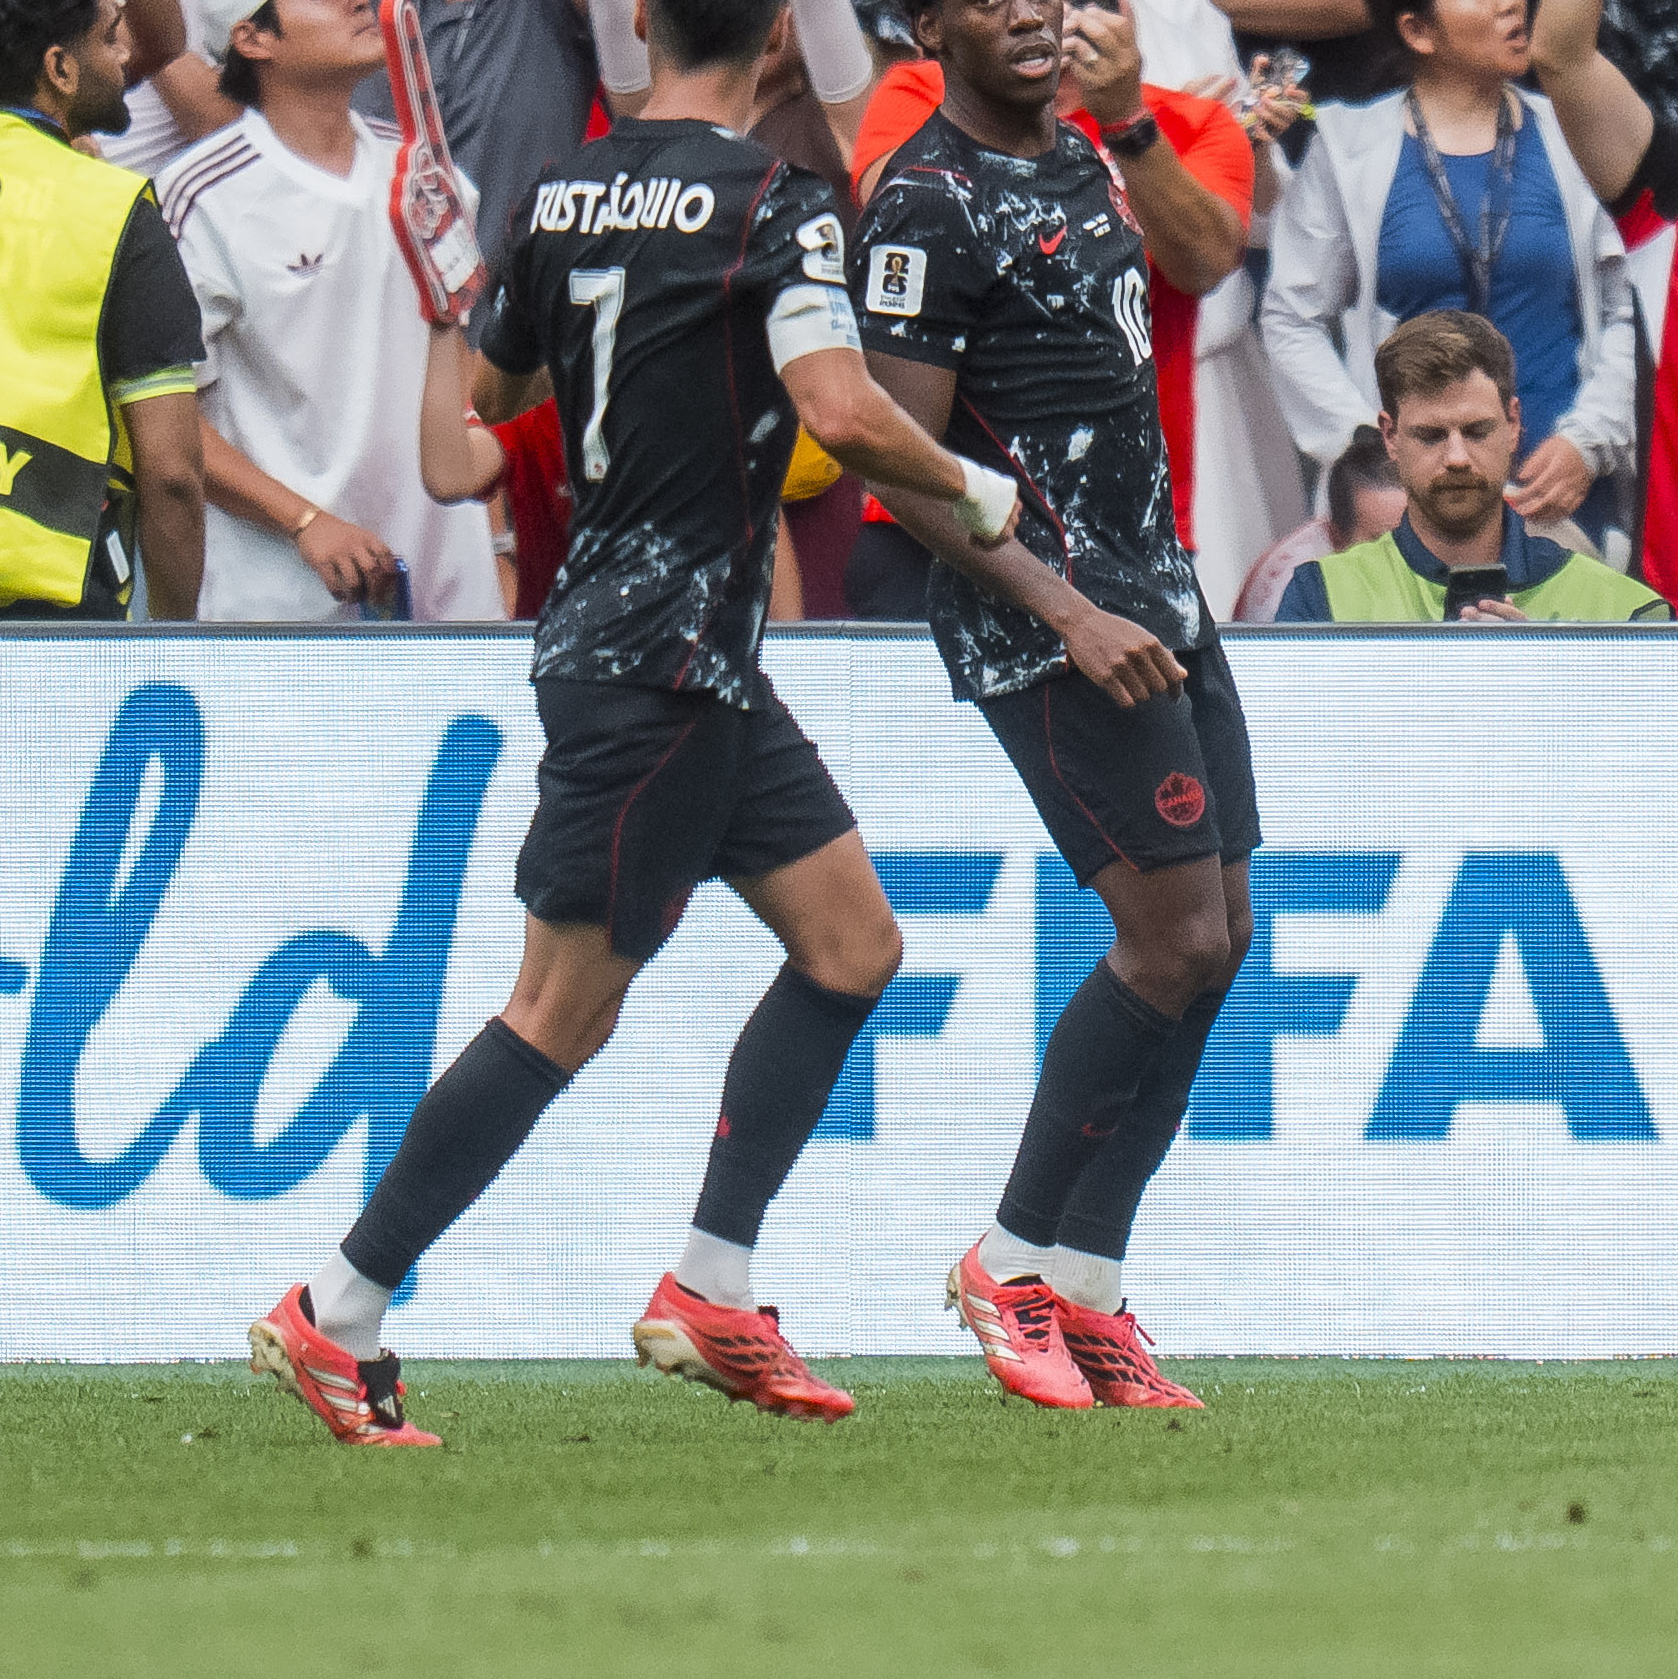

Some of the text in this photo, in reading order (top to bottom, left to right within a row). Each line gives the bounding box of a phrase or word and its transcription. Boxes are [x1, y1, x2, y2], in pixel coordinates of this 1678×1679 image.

[568, 266, 626, 484] 7
[1112, 266, 1153, 368] 10
[806, 851, 1660, 1143] FIFA
